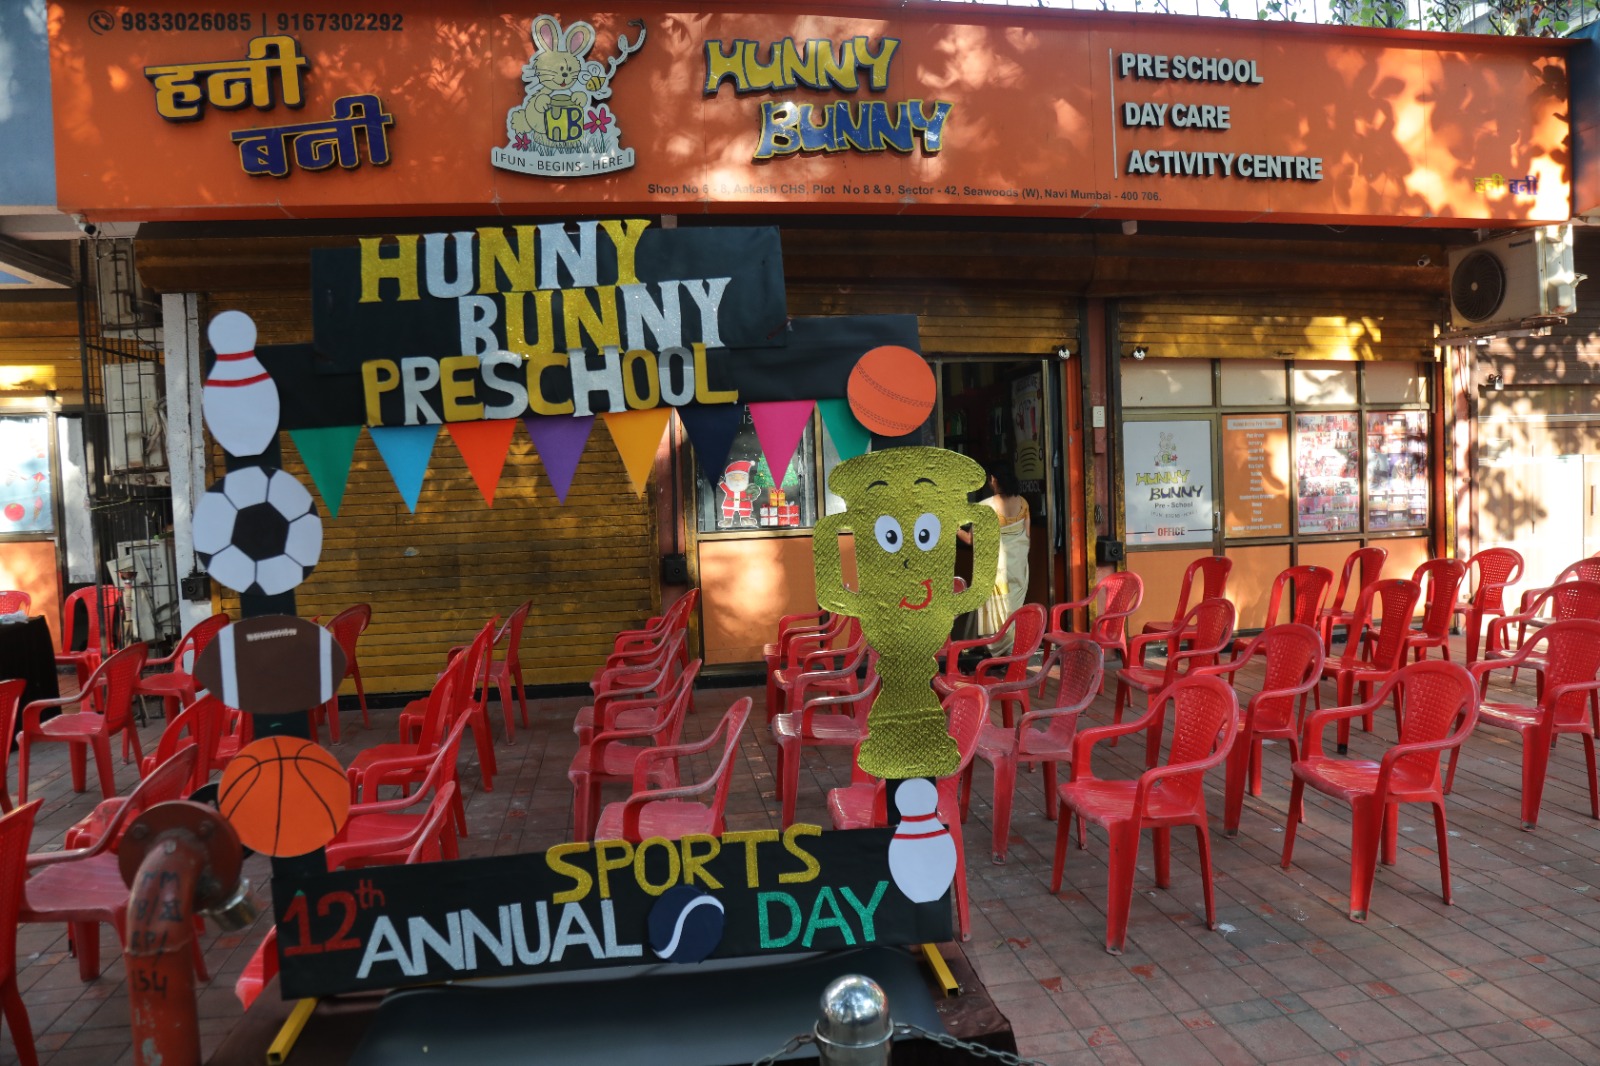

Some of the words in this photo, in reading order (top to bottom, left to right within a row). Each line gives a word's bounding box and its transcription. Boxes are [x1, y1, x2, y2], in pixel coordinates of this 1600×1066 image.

[121, 12, 252, 32] 9833026085
[277, 12, 404, 32] 9167302292
[144, 35, 308, 121] हनी
[704, 36, 900, 94] HUNNY
[1120, 52, 1169, 80] PRE
[1172, 55, 1264, 84] SCHOOL
[230, 93, 393, 178] बनी
[544, 106, 584, 142] HB
[753, 100, 954, 161] BUNNY
[1124, 102, 1170, 128] DAY
[1172, 103, 1231, 130] CARE
[500, 153, 526, 168] FUN
[537, 160, 582, 172] BEGINS
[592, 155, 623, 171] HERE
[1128, 150, 1236, 178] ACTIVITY
[1237, 153, 1323, 181] CENTRE
[648, 184, 679, 195] Shop
[682, 184, 699, 194] No
[734, 184, 777, 194] Aakash
[780, 184, 809, 195] CHS,
[812, 184, 836, 194] Plot
[863, 185, 870, 194] 8
[873, 185, 882, 194] &
[885, 185, 895, 195] 9,
[898, 185, 934, 195] Sector
[944, 185, 960, 196] 42,
[963, 186, 1019, 197] Seawoods
[1022, 188, 1043, 200] (W),
[1045, 189, 1068, 198] Navi
[1070, 190, 1112, 200] Mumbai
[1121, 191, 1138, 201] 400
[358, 219, 652, 303] HUNNY
[458, 277, 732, 361] BUNNY
[361, 342, 739, 427] PRESCHOOL
[1136, 470, 1190, 485] HUNNY
[1149, 485, 1204, 501] BUNNY
[1157, 526, 1185, 537] OFFICE
[545, 824, 822, 904] SPORTS
[282, 876, 386, 957] 12th
[356, 899, 643, 979] ANNUAL
[757, 880, 889, 949] DAY
